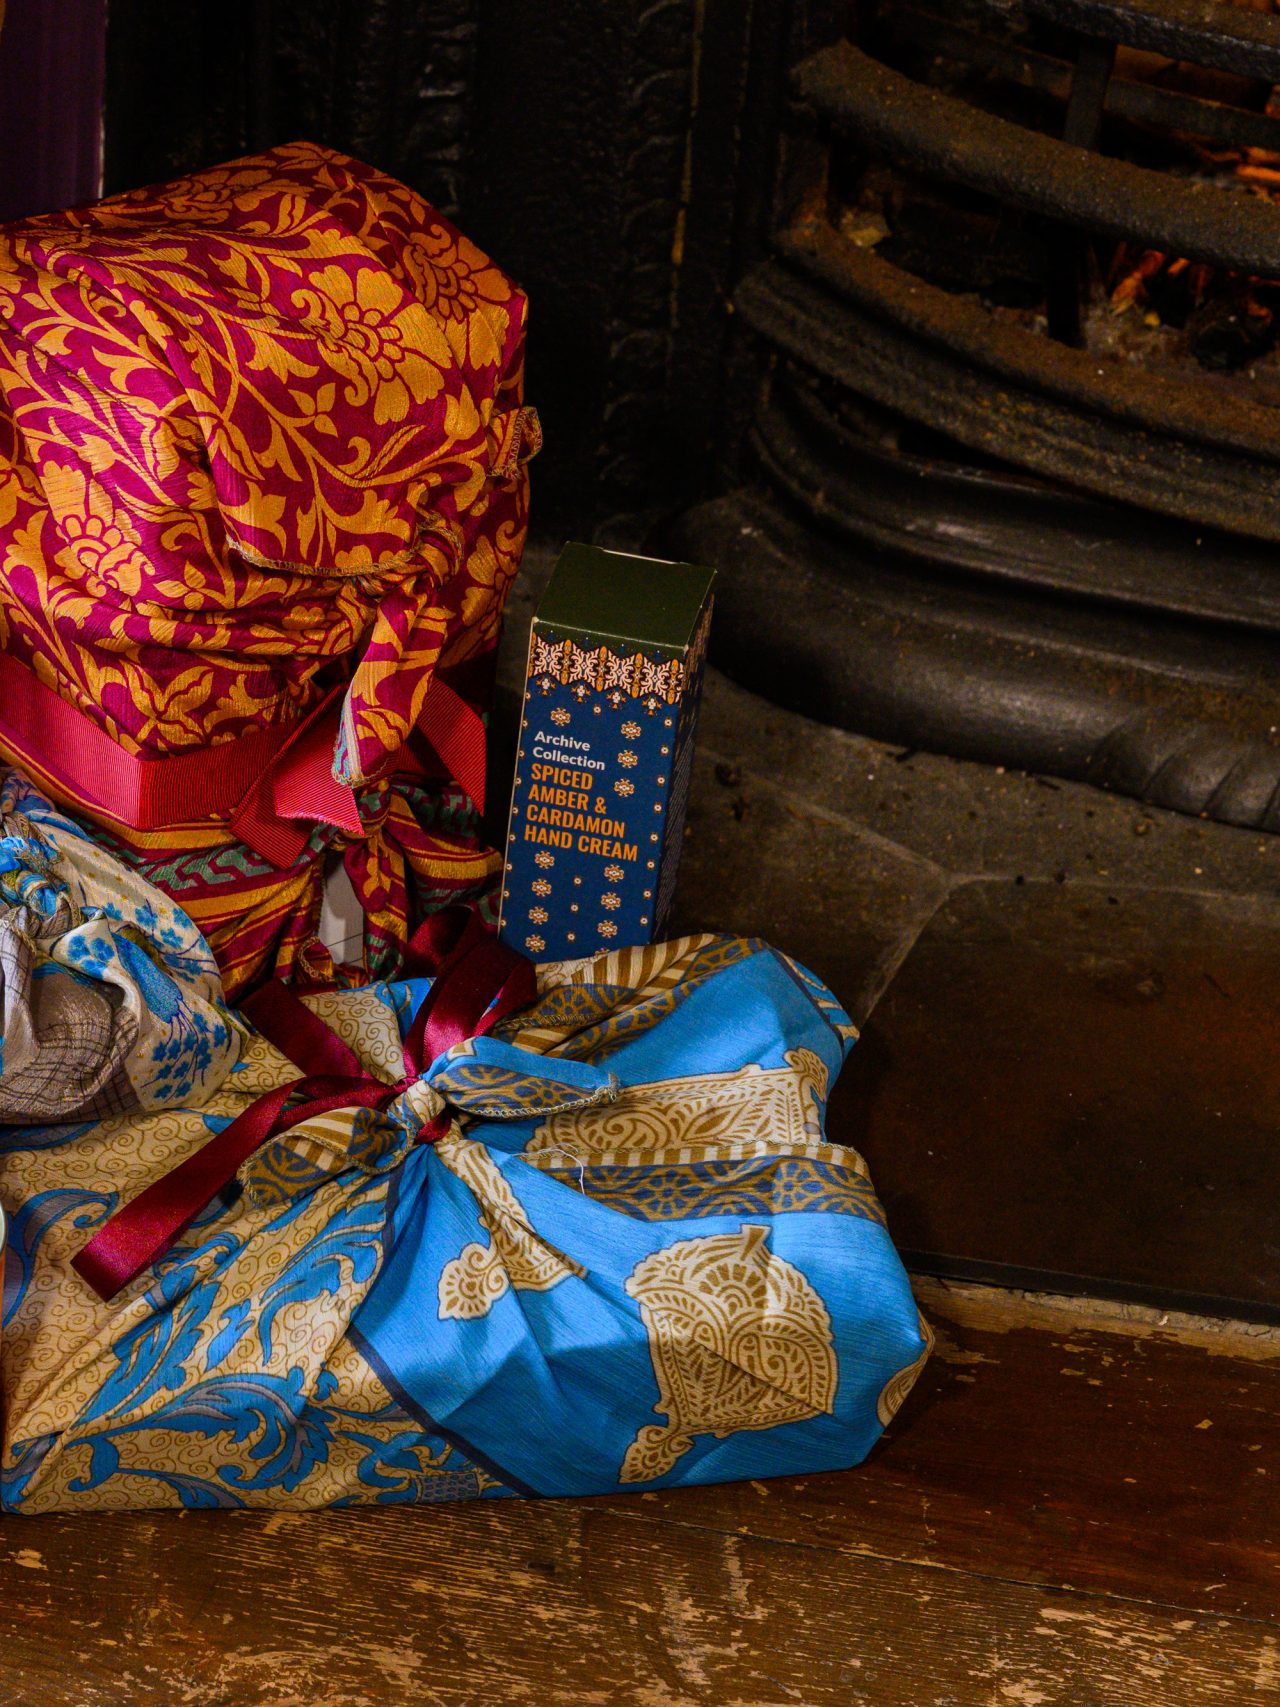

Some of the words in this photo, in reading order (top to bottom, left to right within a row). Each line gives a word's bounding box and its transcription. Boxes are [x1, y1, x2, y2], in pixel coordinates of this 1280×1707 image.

[534, 730, 591, 751] Archive
[532, 746, 606, 771] Collection
[530, 763, 593, 790] SPICED
[528, 784, 589, 811] AMBER
[594, 796, 607, 814] &
[526, 804, 625, 839] CARDAMON
[524, 824, 572, 849] HAND
[577, 835, 638, 862] CREAM
